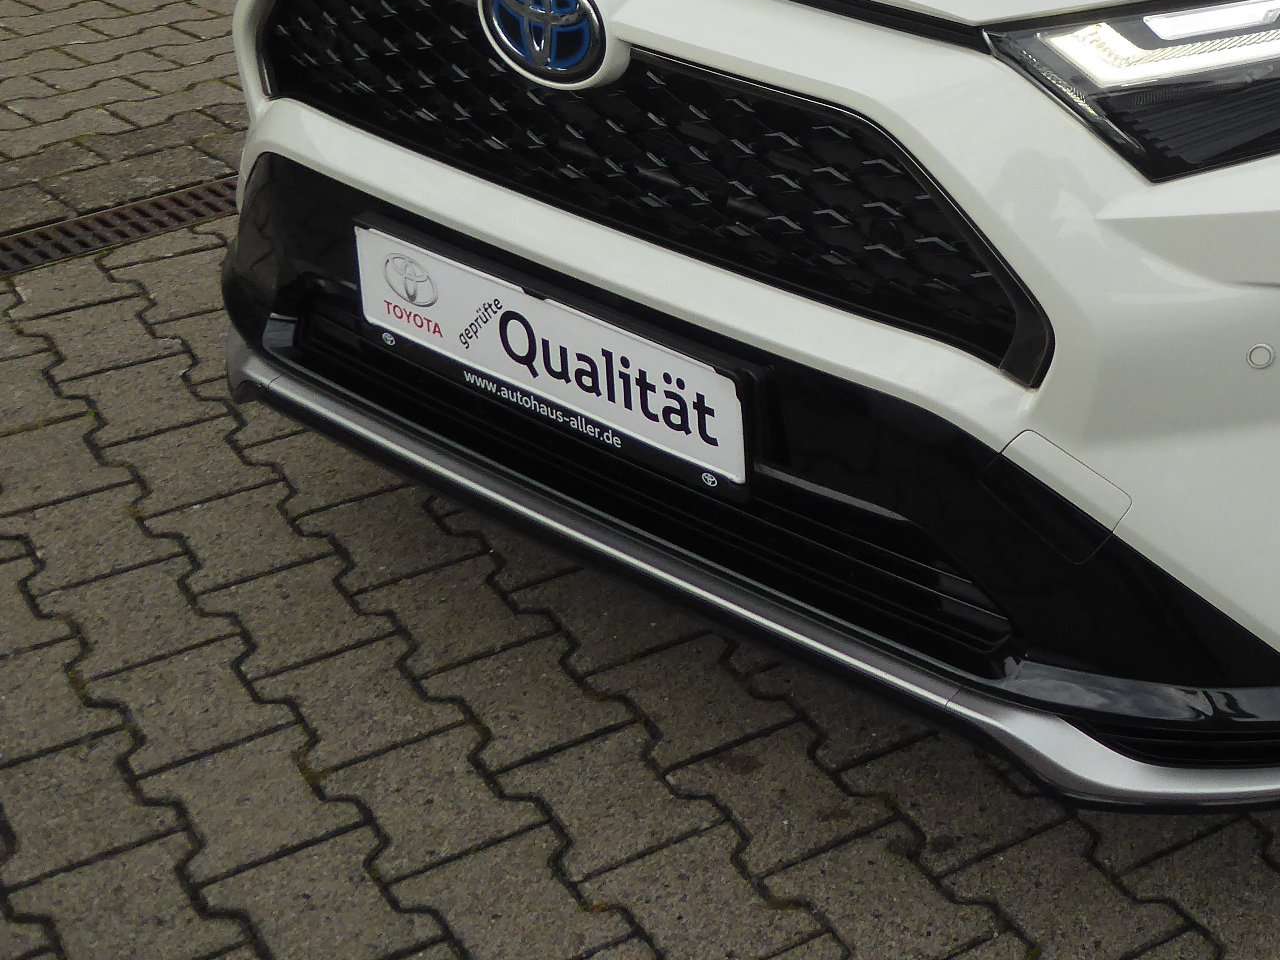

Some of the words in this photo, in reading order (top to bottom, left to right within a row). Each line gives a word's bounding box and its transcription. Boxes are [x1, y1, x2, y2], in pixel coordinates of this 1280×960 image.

[383, 299, 444, 338] TOYOTA
[458, 297, 503, 350] geprüfte
[463, 369, 622, 449] www.autohaus-aller.de
[498, 309, 719, 447] Qualität
